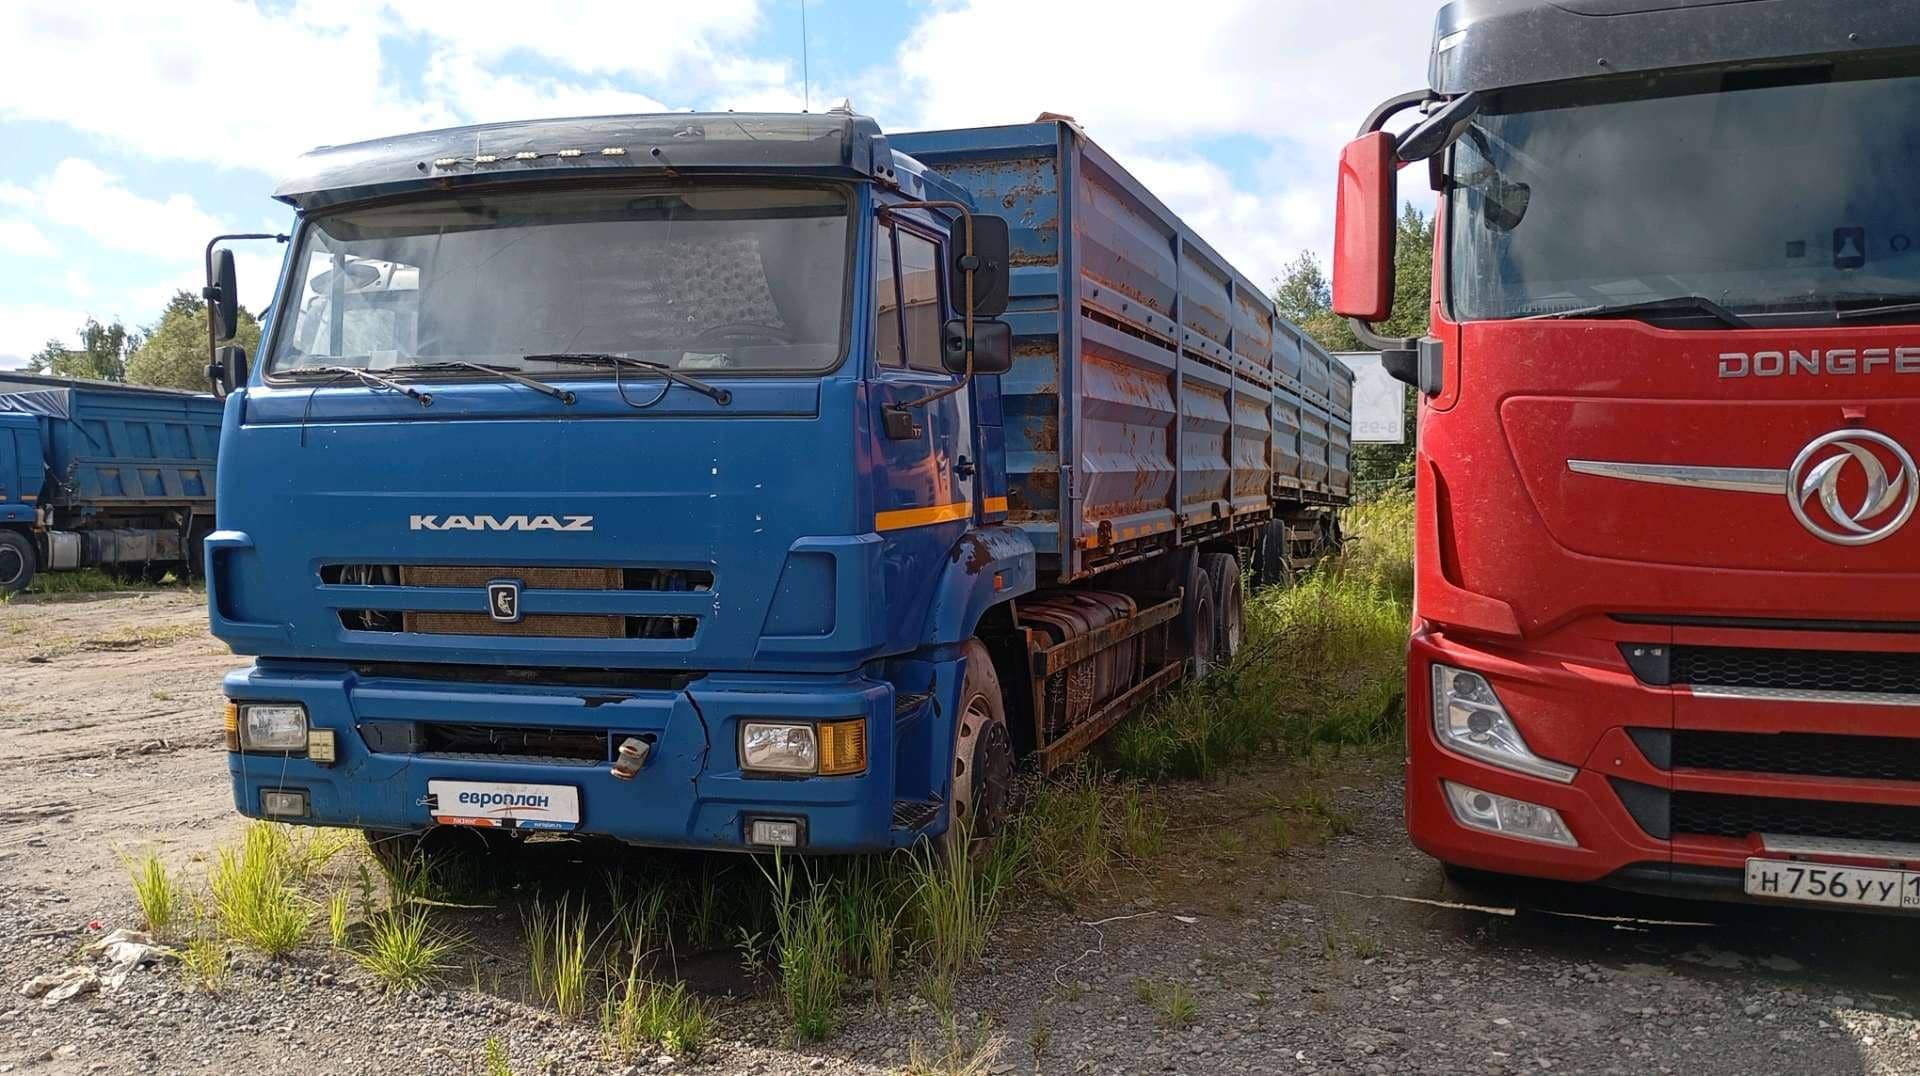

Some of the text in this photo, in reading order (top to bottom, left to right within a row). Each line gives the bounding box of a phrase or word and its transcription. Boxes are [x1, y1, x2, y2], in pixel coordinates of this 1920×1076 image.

[1718, 347, 1920, 378] DONGFE
[410, 515, 593, 531] KAMAZ
[459, 792, 549, 808] европлан
